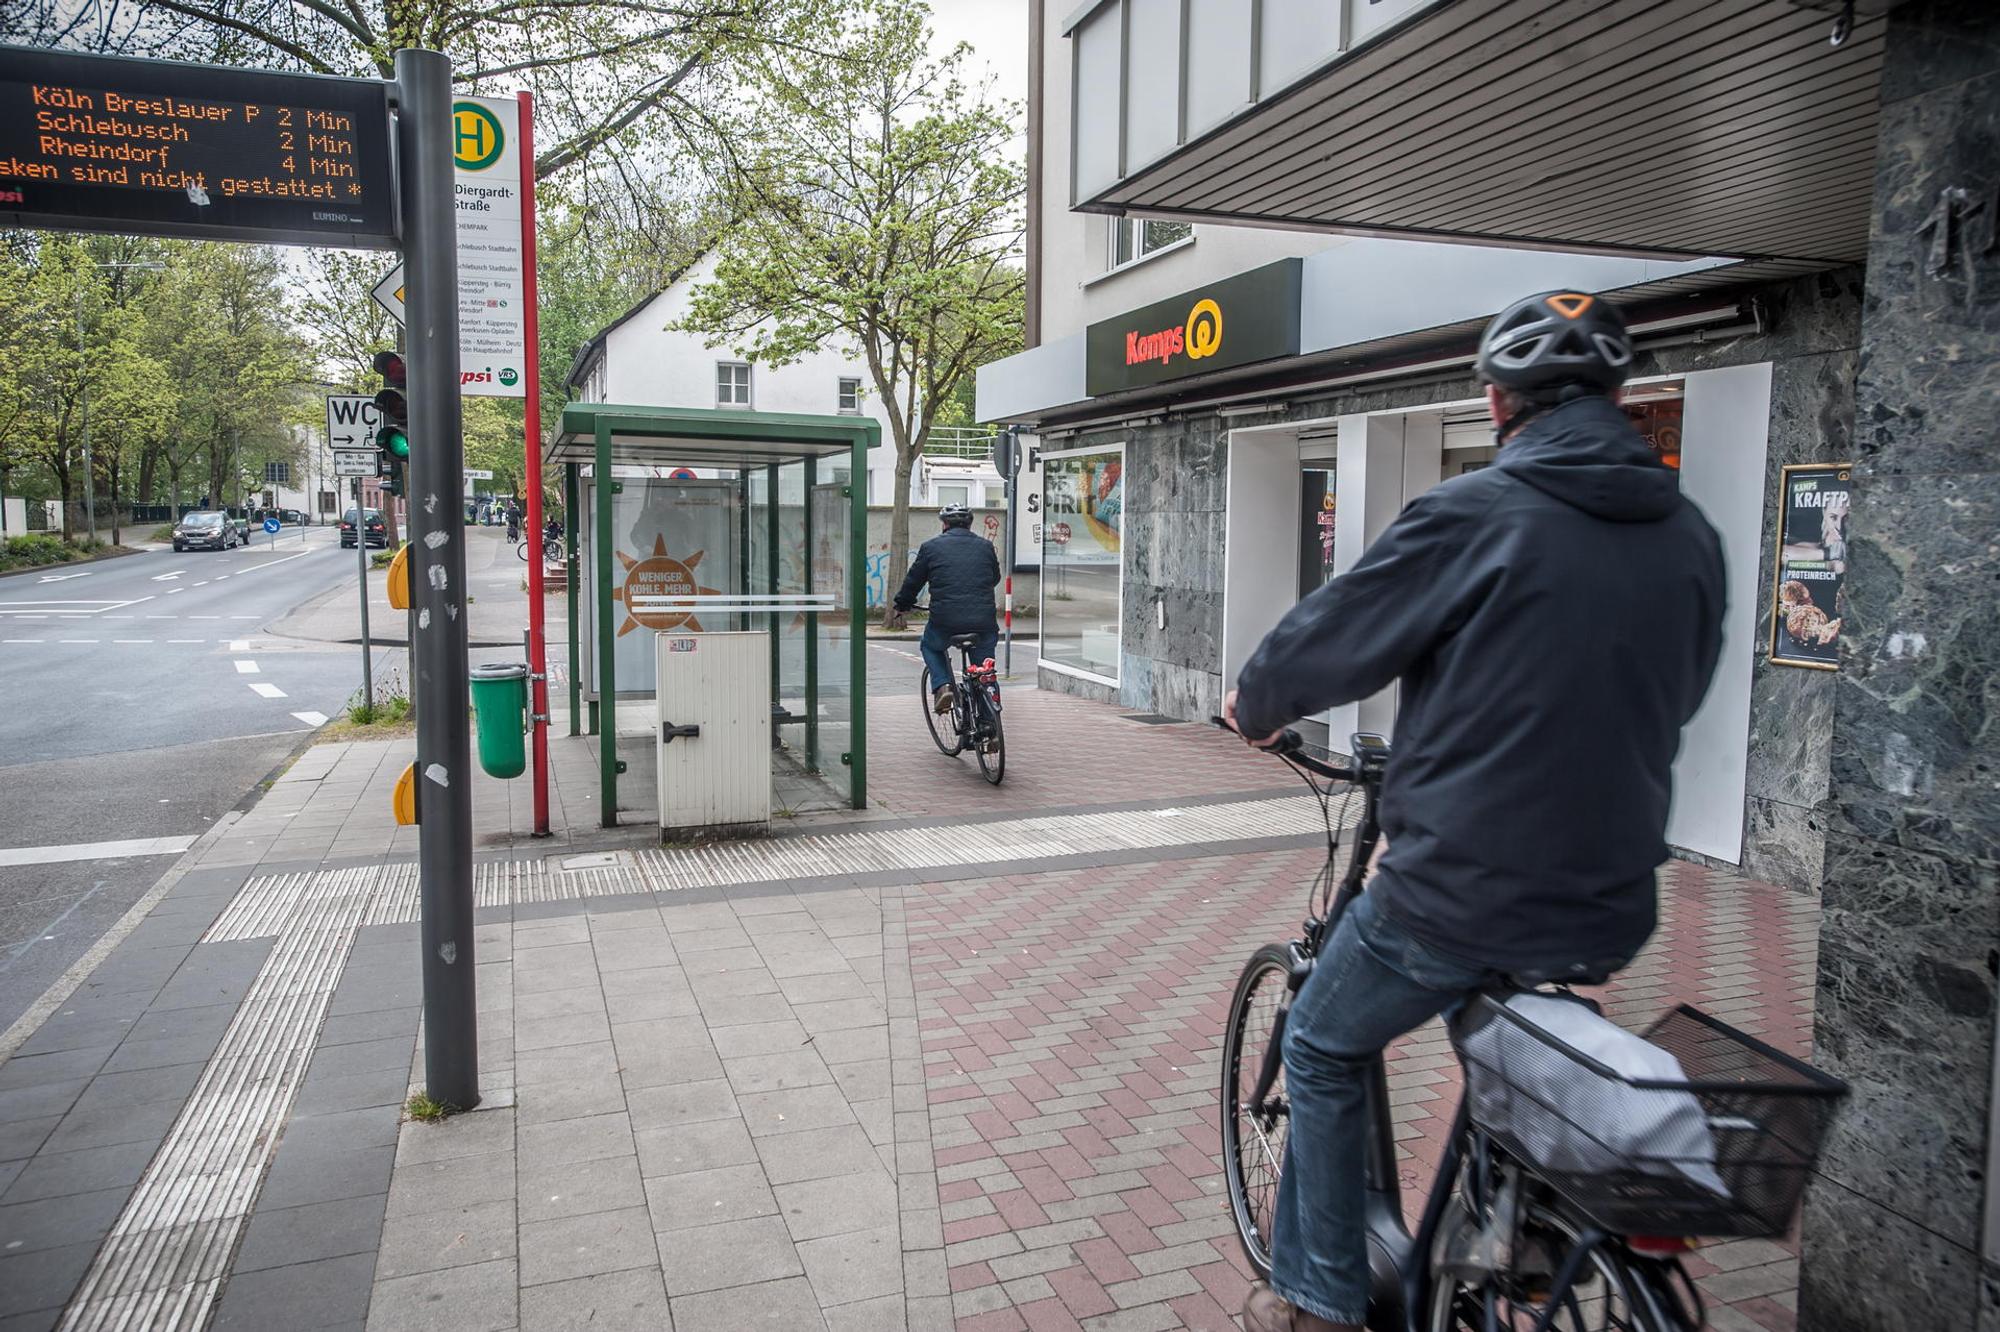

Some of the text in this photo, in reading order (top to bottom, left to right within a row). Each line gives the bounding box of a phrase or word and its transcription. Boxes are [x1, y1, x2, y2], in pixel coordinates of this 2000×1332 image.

[33, 85, 351, 131] Köln Breslauer P 2 Min
[36, 111, 352, 154] Schlebusch 2 Min
[40, 135, 354, 177] Rheindorf 4 Min
[0, 157, 336, 199] sken sind nicht gestattet
[455, 184, 514, 199] Diergardt-
[1126, 326, 1184, 365] Kamps
[498, 370, 514, 379] VRS
[332, 400, 379, 425] WC
[638, 571, 684, 583] WENIGER
[1786, 570, 1836, 580] PROTEINREICH
[664, 583, 693, 595] MEHR
